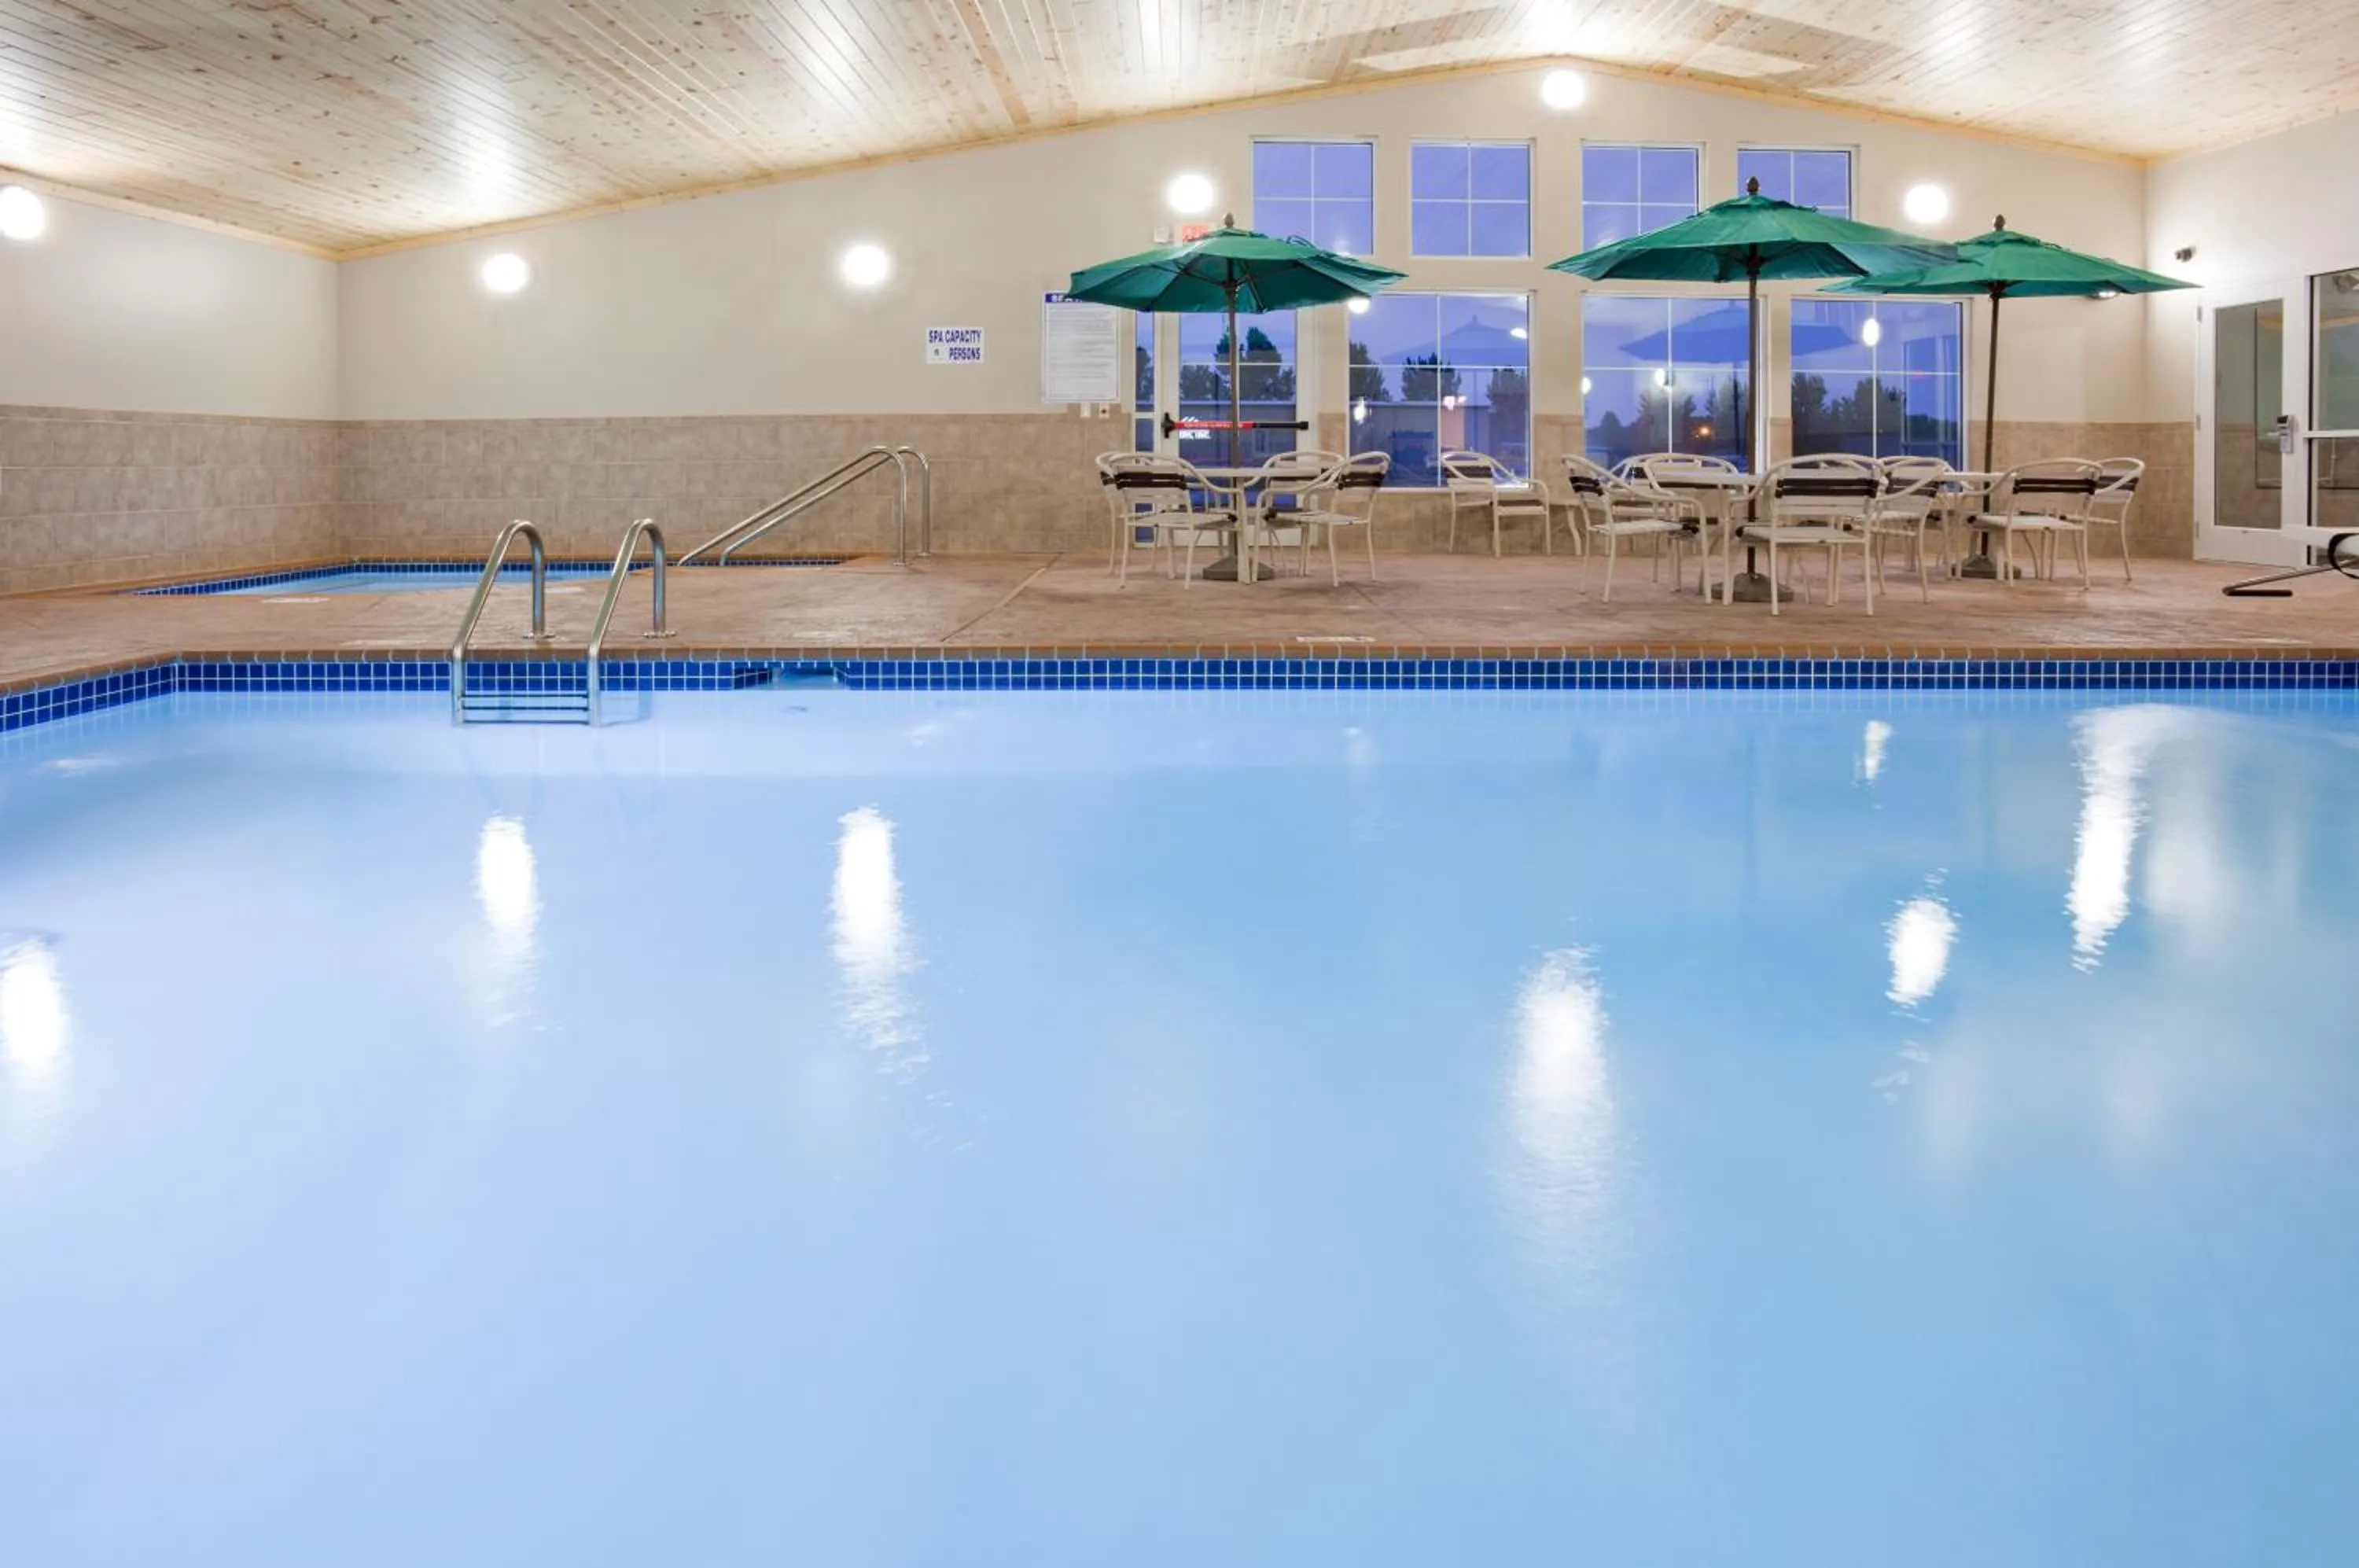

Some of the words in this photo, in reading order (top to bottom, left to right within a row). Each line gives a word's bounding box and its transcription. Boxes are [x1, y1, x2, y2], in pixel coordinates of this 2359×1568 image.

[929, 329, 943, 344] SPA
[945, 329, 982, 344] CAPACITY
[949, 347, 981, 360] PERSONS
